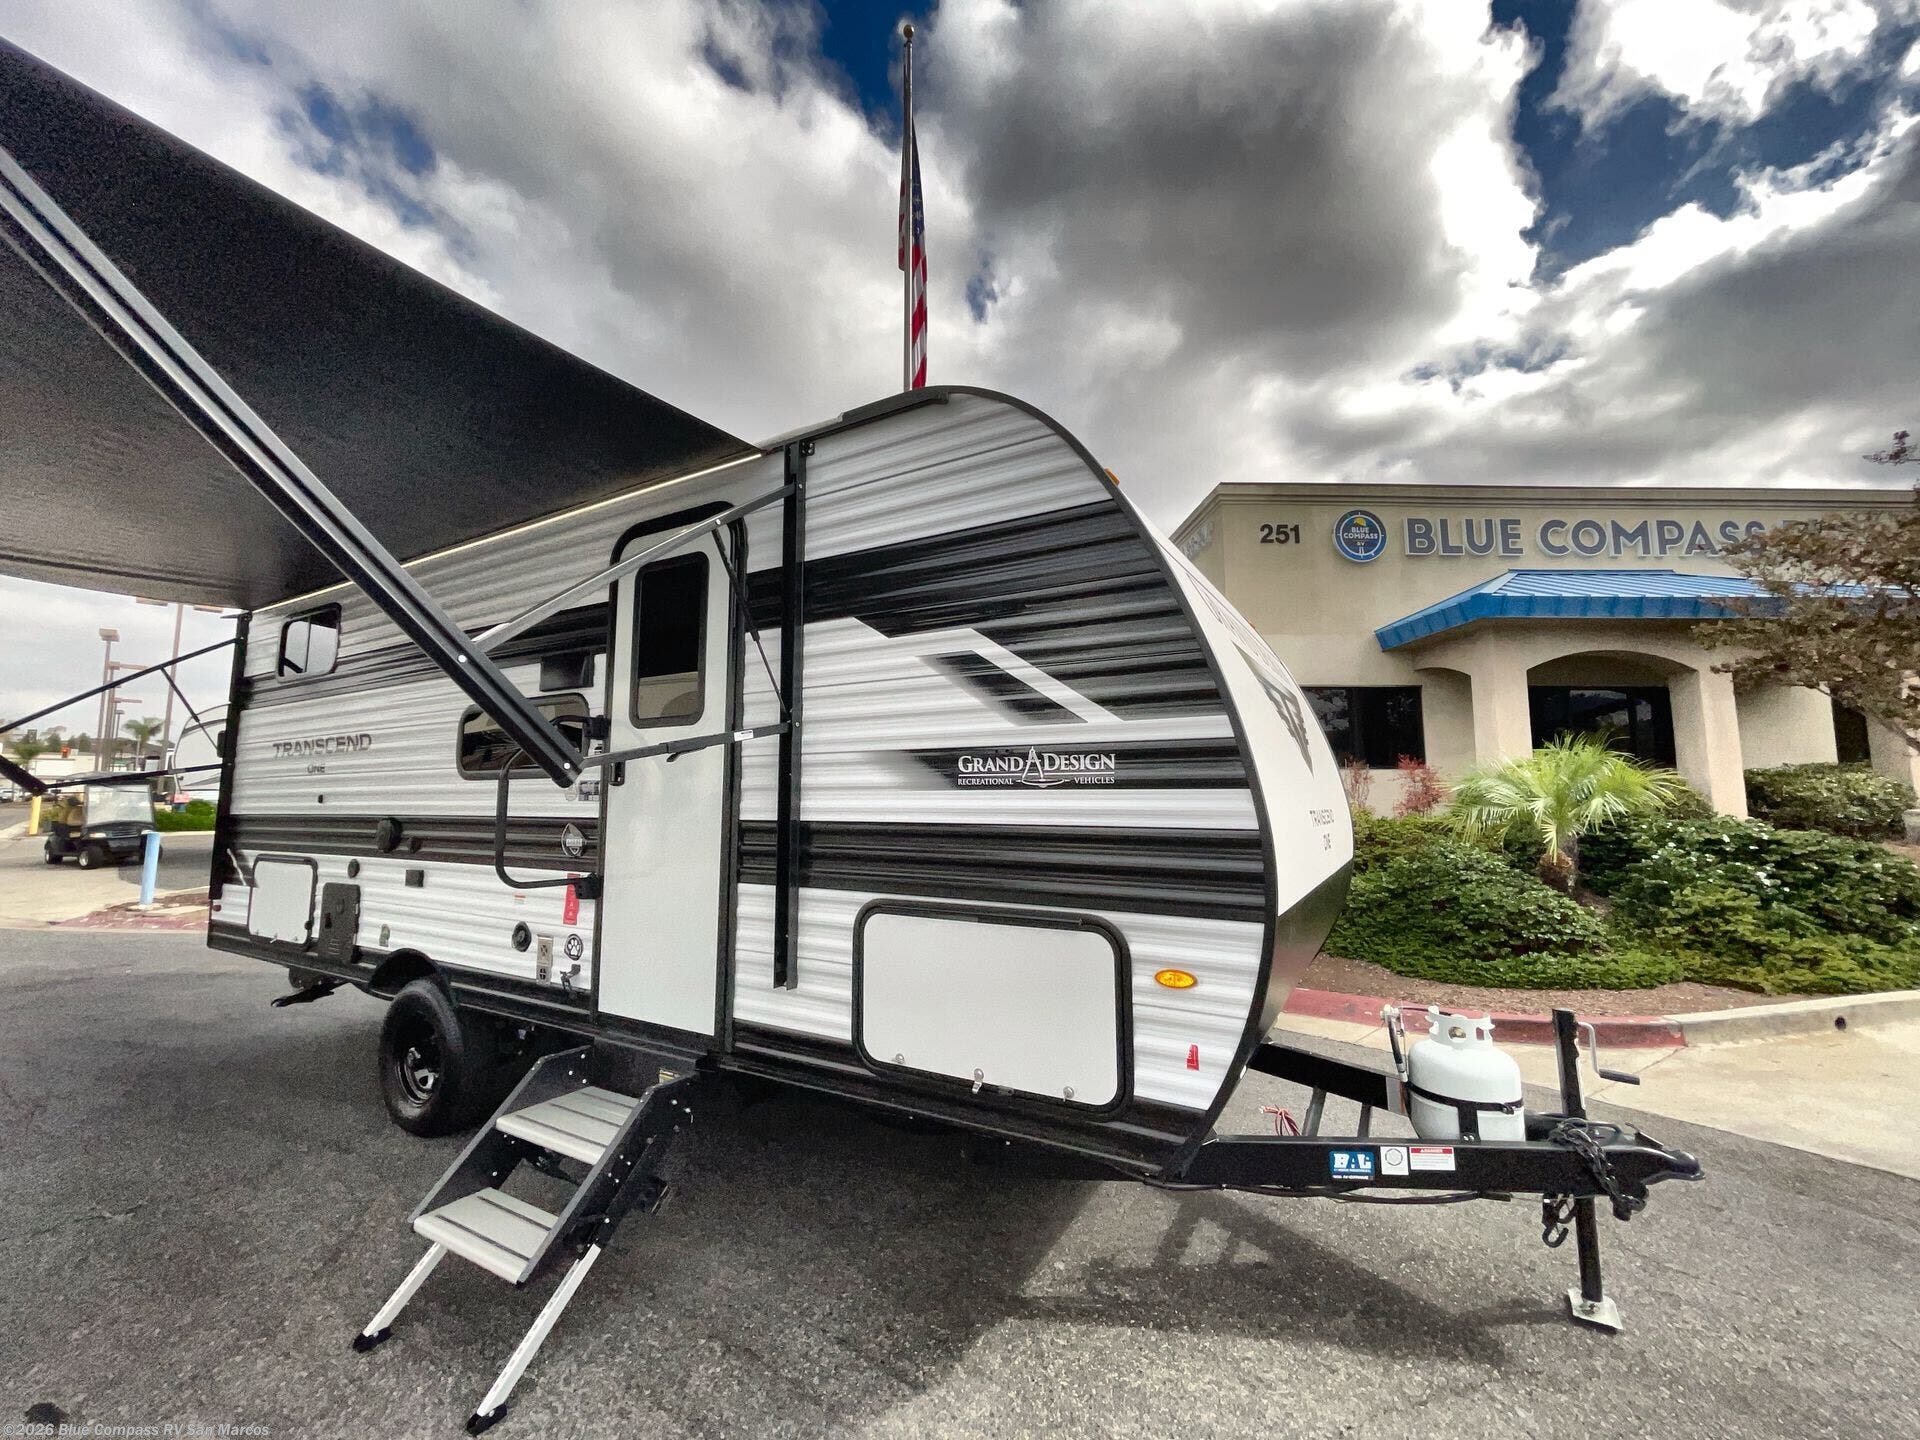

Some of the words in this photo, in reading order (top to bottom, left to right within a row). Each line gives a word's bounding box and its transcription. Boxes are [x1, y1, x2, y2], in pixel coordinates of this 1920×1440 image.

[1259, 523, 1300, 545] 251
[1343, 532, 1379, 540] COMPASS
[1351, 526, 1370, 534] BLUE
[1404, 517, 1525, 556] BLUE
[272, 733, 373, 759] TRANSCEND
[957, 755, 1024, 774] GRAND
[1041, 752, 1116, 772] DESIGN
[957, 776, 1014, 787] RECREATIONAL
[1073, 775, 1116, 785] VEHICLES
